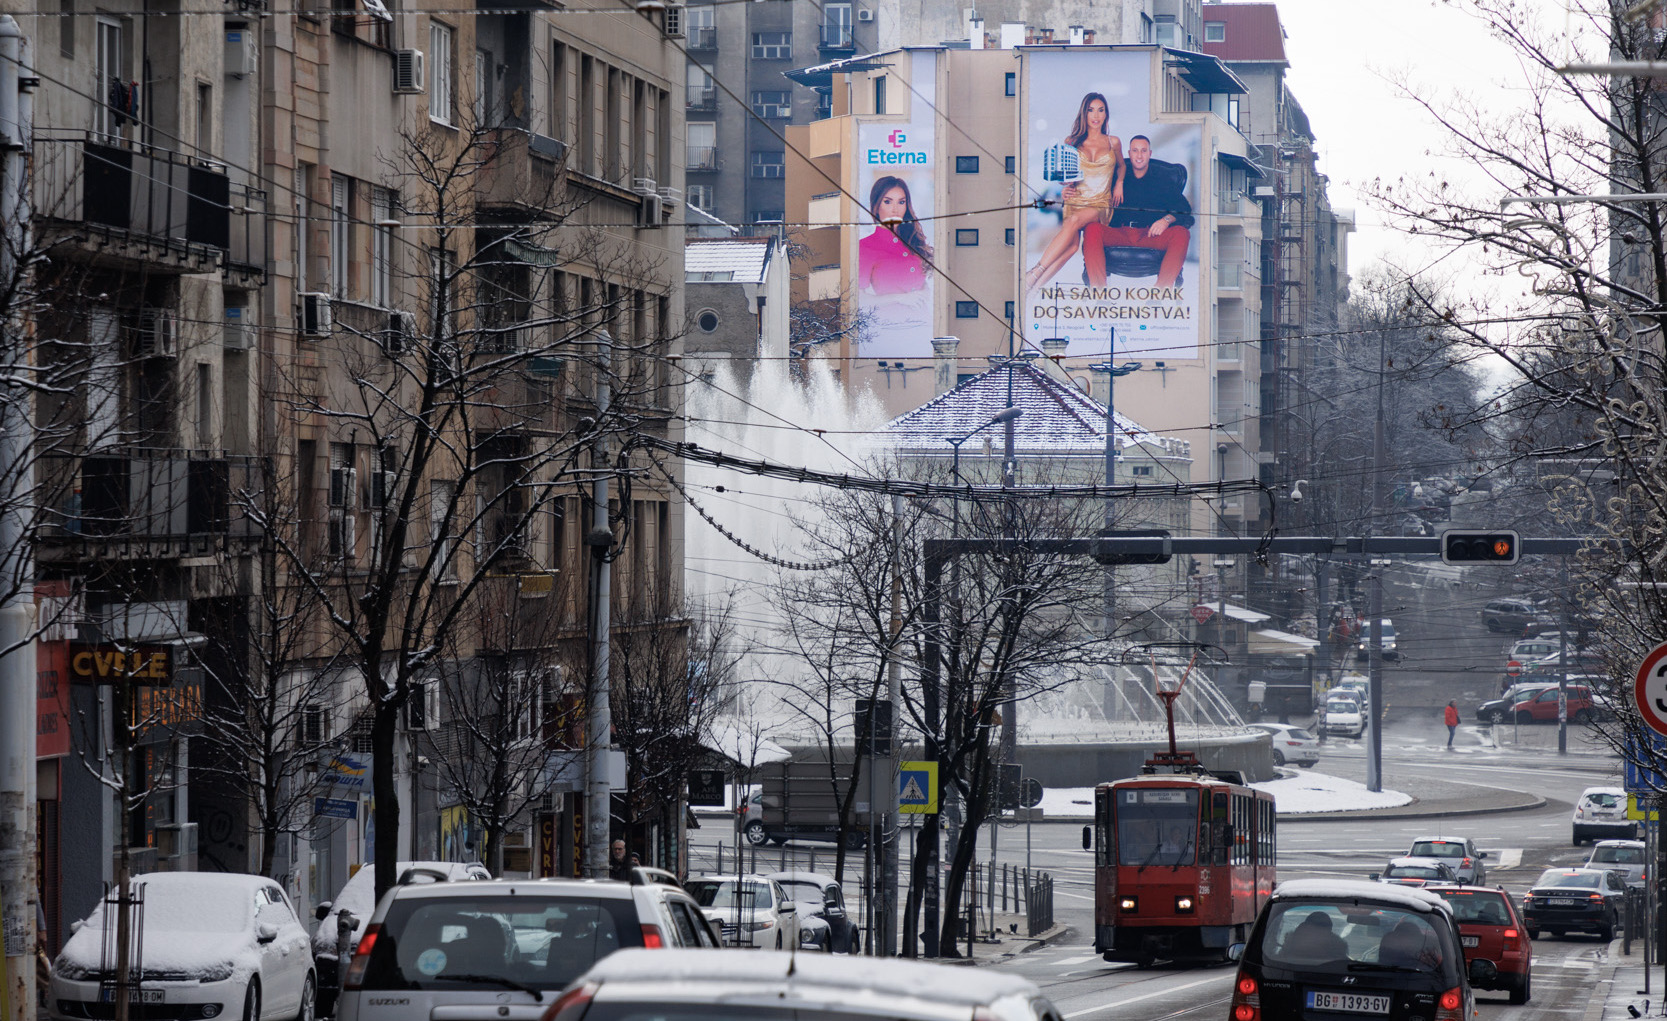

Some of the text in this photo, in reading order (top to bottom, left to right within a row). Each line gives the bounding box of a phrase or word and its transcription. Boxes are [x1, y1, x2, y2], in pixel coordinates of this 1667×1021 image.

[868, 149, 927, 164] Eterna
[1041, 287, 1184, 300] NA SAMO KORAK
[1034, 302, 1190, 319] DO SAVRŠENSTVA!
[368, 997, 410, 1006] SUZUKI
[1316, 994, 1331, 1008] BG
